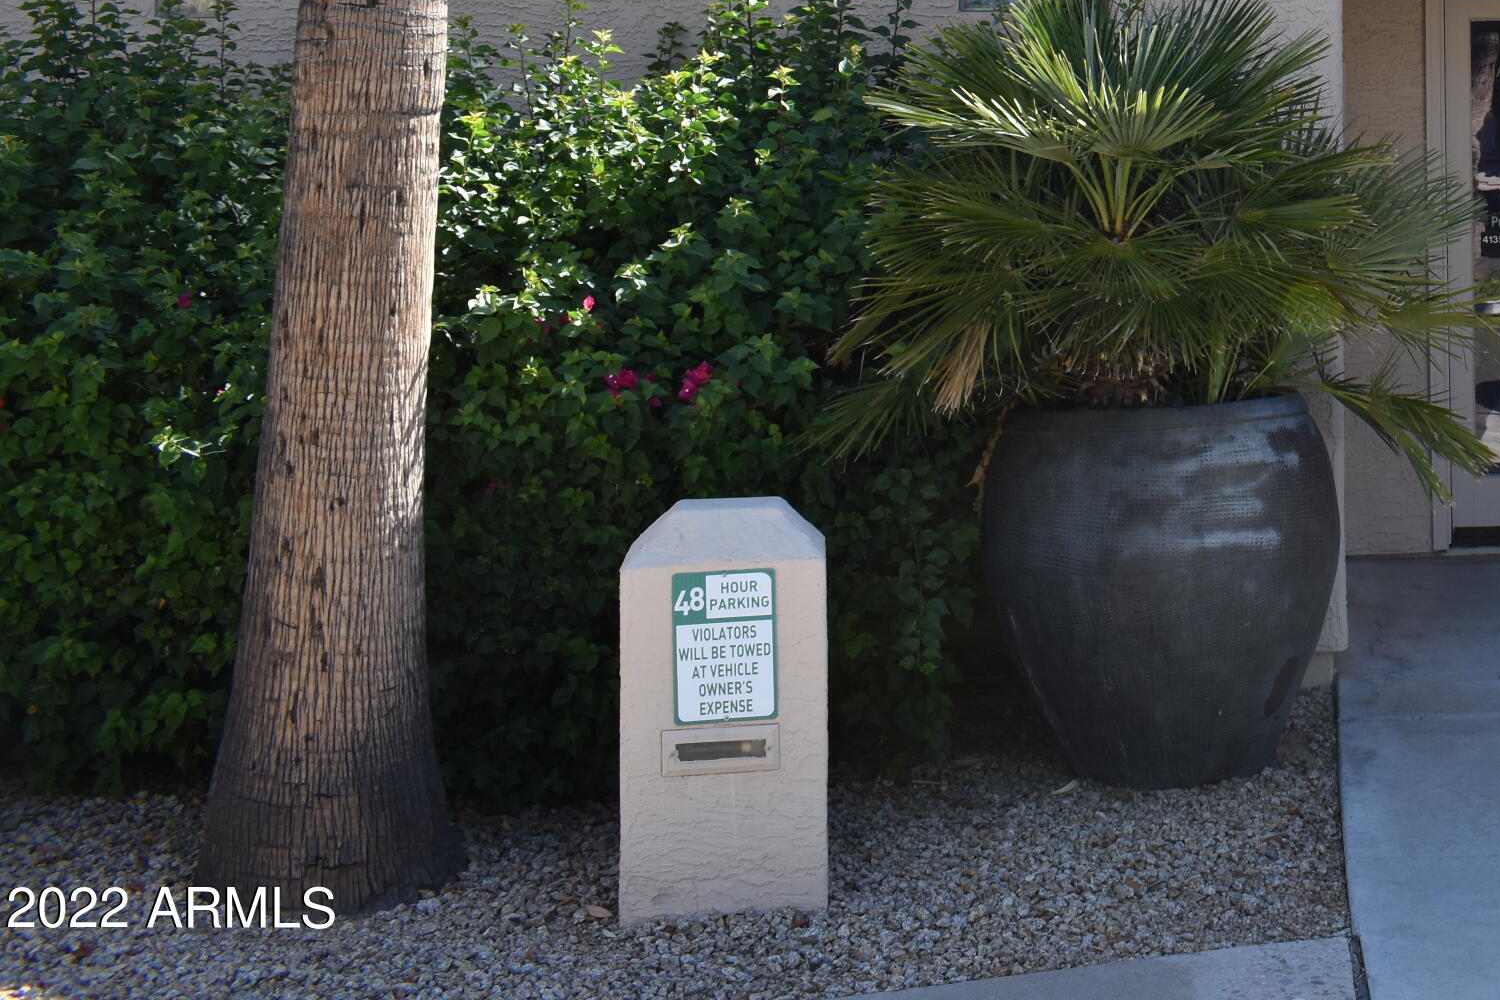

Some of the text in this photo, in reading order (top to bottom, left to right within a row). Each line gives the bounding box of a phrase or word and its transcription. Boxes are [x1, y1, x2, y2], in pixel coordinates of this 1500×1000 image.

[720, 580, 758, 594] HOUR
[674, 587, 705, 616] 48
[709, 596, 770, 611] PARKING
[692, 625, 757, 641] VIOLATORS
[679, 643, 771, 662] WILL BE TOWED
[692, 662, 759, 679] AT VEHICLE
[699, 681, 753, 697] OWNER'S
[700, 699, 753, 716] EXPENSE
